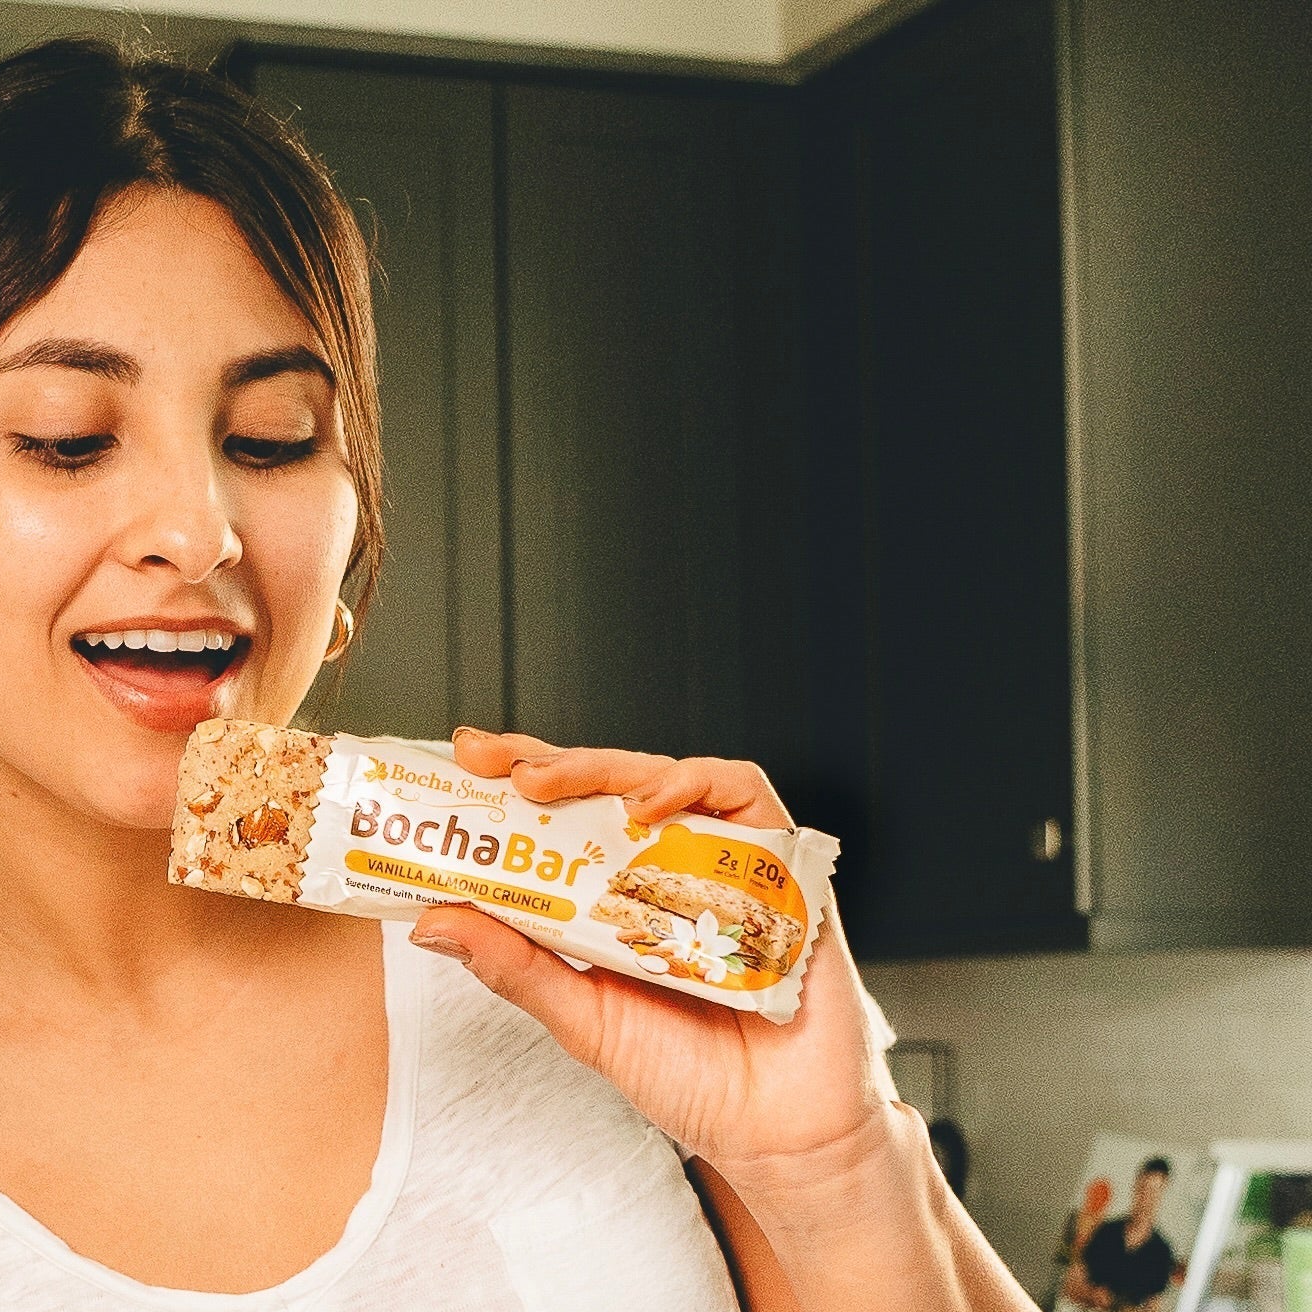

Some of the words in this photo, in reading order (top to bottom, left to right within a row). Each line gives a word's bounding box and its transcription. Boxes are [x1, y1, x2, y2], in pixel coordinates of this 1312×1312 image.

[390, 763, 453, 795] Bocha
[456, 779, 509, 808] Sweet
[350, 799, 590, 888] BochaBar
[345, 877, 391, 896] Sweetened
[393, 888, 413, 901] with
[367, 858, 423, 883] VANILLA
[427, 872, 489, 897] ALMOND
[492, 887, 552, 913] CRUNCH
[717, 849, 739, 871] 2g
[753, 858, 786, 890] 20g
